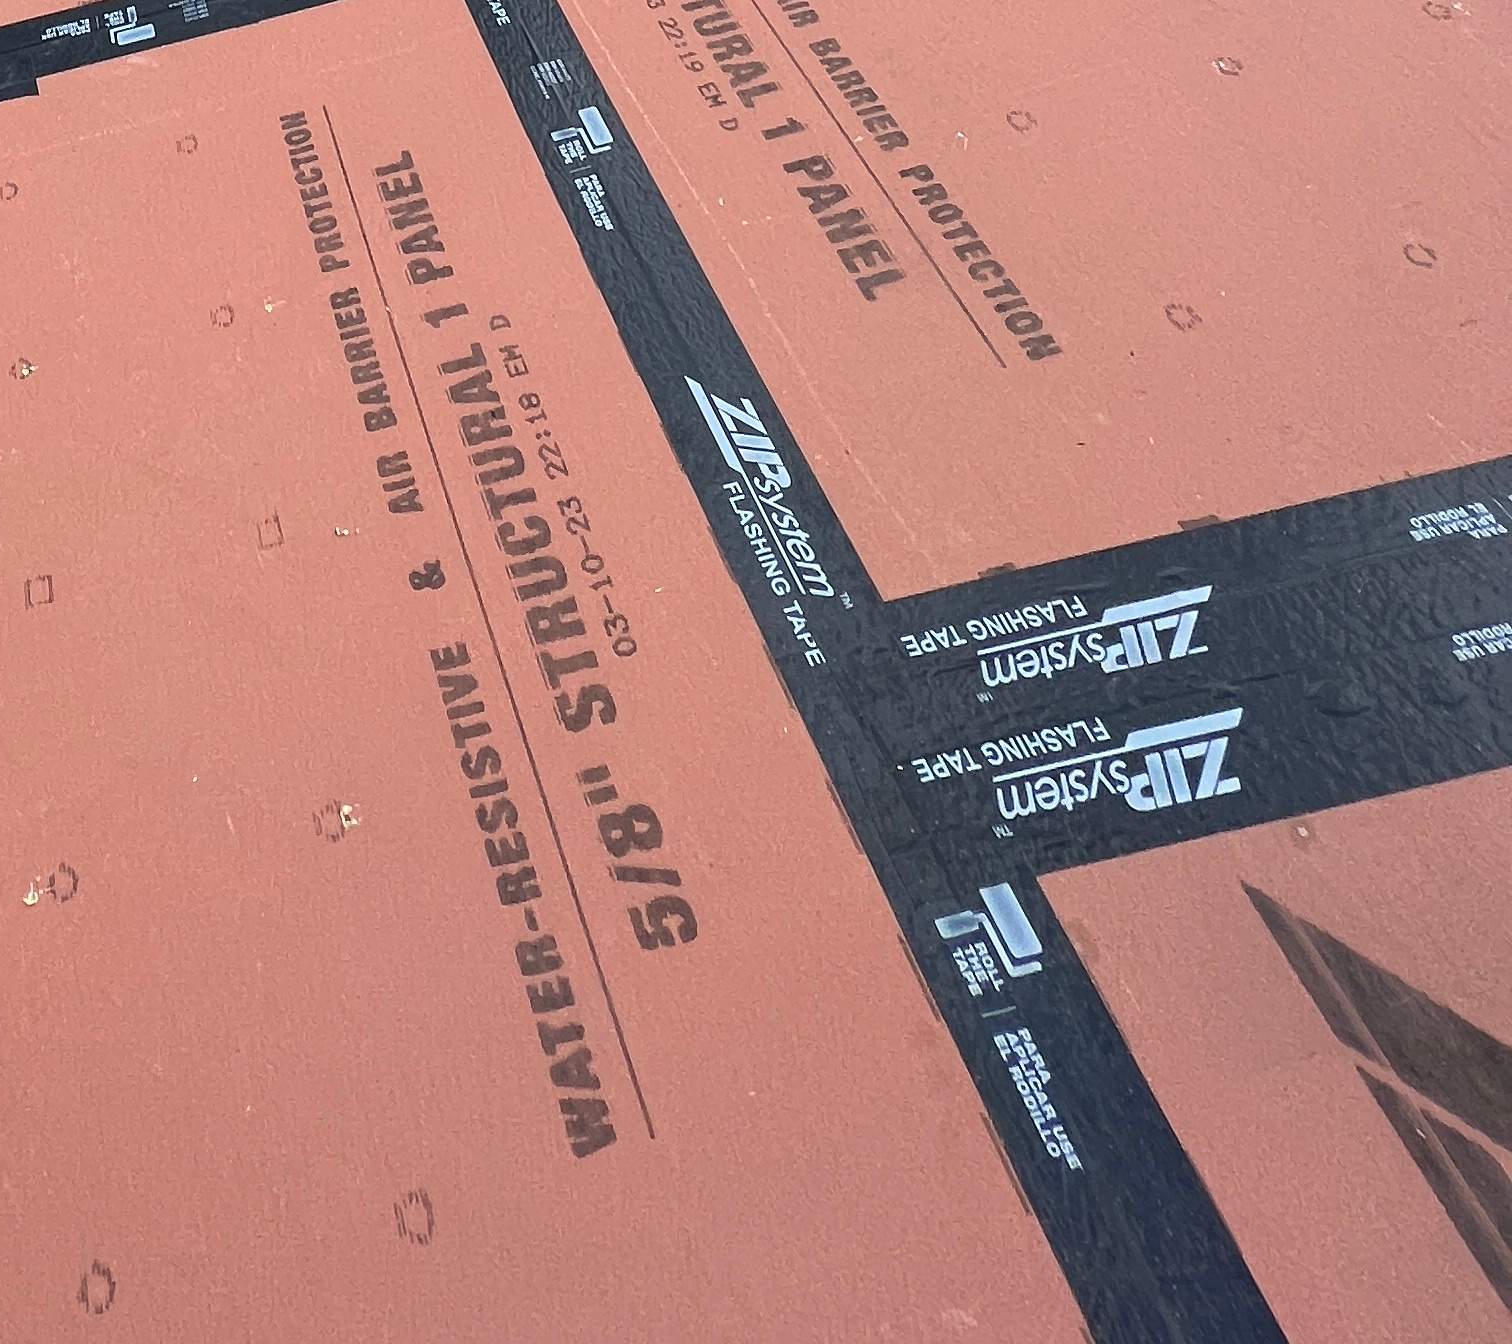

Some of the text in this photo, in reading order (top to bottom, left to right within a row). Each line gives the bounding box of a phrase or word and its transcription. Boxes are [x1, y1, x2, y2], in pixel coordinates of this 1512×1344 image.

[719, 116, 740, 132] D
[761, 117, 804, 140] 1
[784, 156, 905, 302] PANEL
[809, 35, 907, 153] BARRIER
[899, 165, 1059, 364] PROTECTION
[491, 314, 511, 329] D
[1410, 503, 1488, 528] EL RODILLO
[373, 151, 697, 950] 5/8" STRUCTURAL 1 PANEL
[557, 498, 637, 657] 03-10-23
[722, 481, 826, 668] FLASHING TAPE
[280, 112, 618, 1157] WATER-RESISTIVE & AIR BARRIER PROTECTION
[900, 595, 1088, 657] FLASHING TAPE
[912, 717, 1112, 784] FLASHING TAPE
[953, 947, 983, 997] TAPE
[965, 944, 988, 983] THE
[974, 941, 1003, 992] ROLL
[1018, 1028, 1051, 1084] PARA
[993, 1034, 1062, 1158] EL RODILLO
[1005, 1033, 1084, 1170] APLICAR USE
